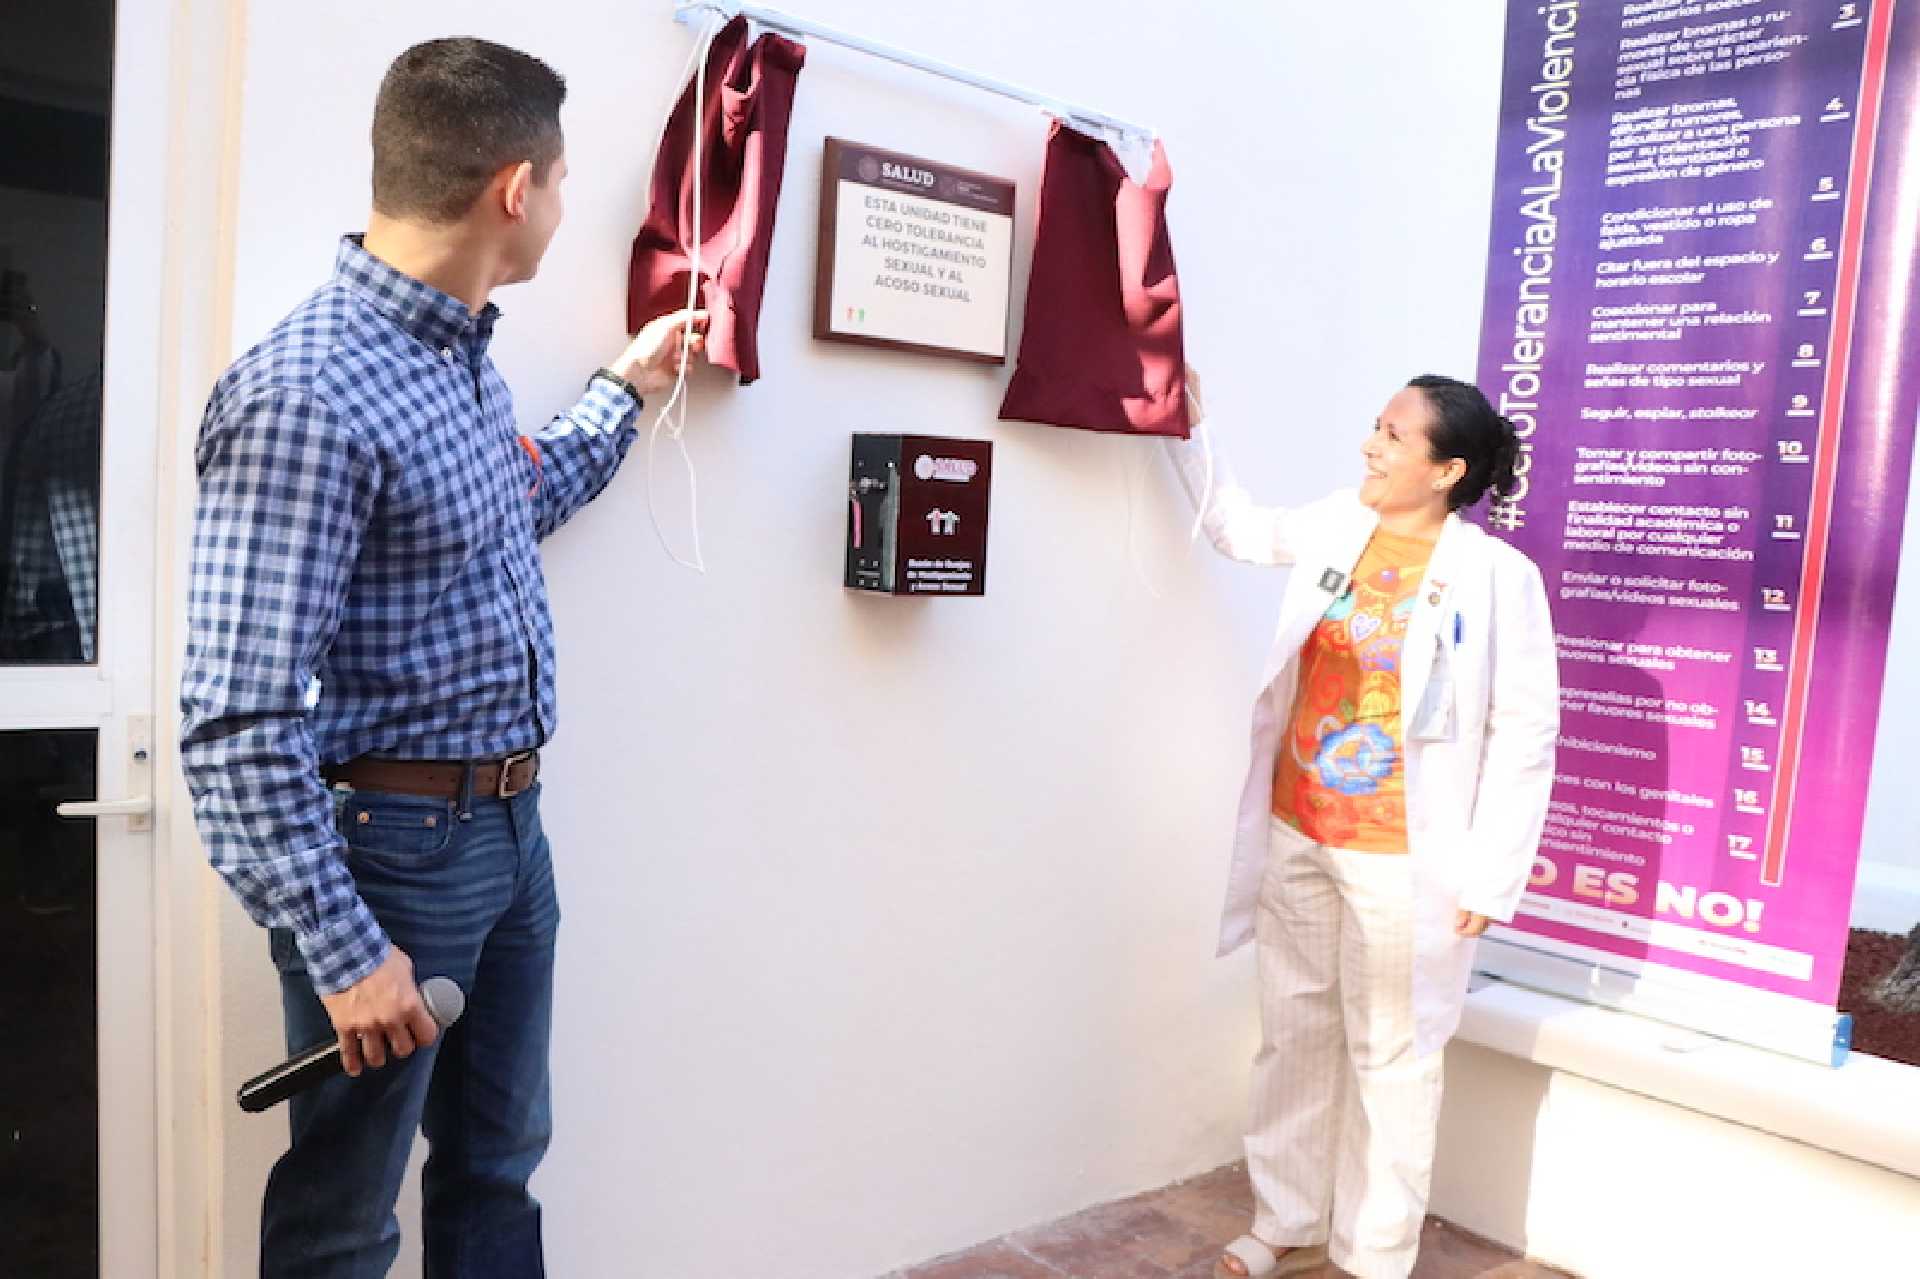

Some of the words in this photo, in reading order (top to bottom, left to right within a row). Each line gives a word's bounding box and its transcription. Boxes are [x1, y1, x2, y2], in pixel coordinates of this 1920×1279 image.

[1620, 32, 1681, 50] Realizar
[1683, 20, 1749, 38] bromas
[1751, 15, 1762, 26] o
[1619, 47, 1667, 62] mores
[1669, 41, 1693, 53] de
[1667, 51, 1714, 65] sobre
[1717, 46, 1733, 57] la
[1683, 63, 1706, 75] de
[1708, 60, 1733, 72] las
[1615, 88, 1642, 100] nas
[1825, 99, 1844, 111] 4
[1611, 106, 1671, 124] Realizar
[1682, 128, 1695, 140] a
[1695, 125, 1730, 137] una
[1730, 115, 1801, 132] persona
[1607, 151, 1633, 164] por
[1638, 146, 1657, 157] su
[1657, 148, 1736, 167] identidad
[1736, 146, 1751, 158] o
[882, 161, 935, 187] SALUD
[1679, 164, 1702, 179] de
[1818, 177, 1834, 191] 5
[864, 196, 898, 215] ESTA
[900, 201, 951, 226] UNIDAD
[953, 213, 988, 234] TIENE
[1602, 205, 1697, 224] Condicionar
[1697, 200, 1714, 215] el
[1715, 201, 1746, 213] uso
[1747, 195, 1774, 209] de
[1642, 216, 1702, 232] vestido
[1703, 216, 1717, 228] o
[1717, 214, 1757, 228] ropa
[865, 214, 903, 233] CERO
[905, 222, 986, 251] TOLERANCIA
[861, 234, 879, 249] AL
[882, 238, 987, 270] HOSTIGAMIENTO
[1811, 237, 1828, 252] 6
[884, 255, 935, 279] SEXUAL
[937, 267, 946, 279] Y
[948, 270, 964, 285] AL
[1632, 259, 1673, 273] fuera
[1675, 255, 1702, 269] del
[1703, 250, 1767, 268] espacio
[1766, 251, 1781, 266] y
[874, 273, 921, 294] ACOSO
[923, 281, 972, 304] SEXUAL
[1595, 274, 1648, 289] horario
[1649, 271, 1706, 285] escolar
[1803, 291, 1822, 305] 7
[1679, 302, 1717, 315] para
[1590, 317, 1667, 330] mantener
[1669, 315, 1701, 327] una
[1587, 329, 1683, 341] sentimental
[1796, 344, 1815, 358] 8
[1585, 362, 1646, 376] Realizar
[1646, 359, 1751, 375] comentarios
[1751, 361, 1767, 375] y
[1628, 376, 1650, 388] de
[1652, 374, 1685, 389] tipo
[1686, 373, 1742, 387] sexual
[1790, 394, 1809, 409] 9
[1576, 447, 1628, 460] Tomar
[1637, 448, 1719, 463] compartir
[1777, 441, 1803, 455] 10
[1683, 462, 1708, 474] sin
[1573, 473, 1666, 488] sentimiento
[1568, 501, 1648, 515] Establecer
[1648, 505, 1722, 517] contacto
[1723, 506, 1750, 520] sin
[1726, 522, 1742, 534] o
[1775, 514, 1794, 529] 11
[1564, 527, 1617, 540] laboral
[1616, 530, 1646, 545] por
[1563, 540, 1612, 552] medio
[1613, 541, 1635, 554] de
[1562, 571, 1610, 585] Enviar
[1610, 574, 1624, 586] o
[1623, 576, 1686, 592] solicitar
[1667, 596, 1742, 612] sexuales
[1761, 588, 1786, 604] 12
[1626, 644, 1665, 657] para
[1664, 647, 1733, 663] obtener
[1607, 655, 1676, 672] sexuales
[1635, 697, 1664, 710] por
[1664, 700, 1689, 712] no
[1743, 700, 1771, 717] 14
[1587, 703, 1645, 720] favores
[1646, 712, 1717, 730] sexuales
[1740, 746, 1766, 762] 15
[1583, 777, 1613, 791] con
[1614, 781, 1637, 796] los
[1638, 787, 1714, 808] genitales
[1734, 789, 1759, 804] 16
[1582, 805, 1681, 833] tocamientos
[1681, 824, 1696, 836] o
[1569, 831, 1592, 843] sin
[1602, 823, 1673, 846] contacto
[1727, 834, 1753, 850] 17
[1572, 865, 1641, 904] ES
[1654, 880, 1766, 933] NO!
